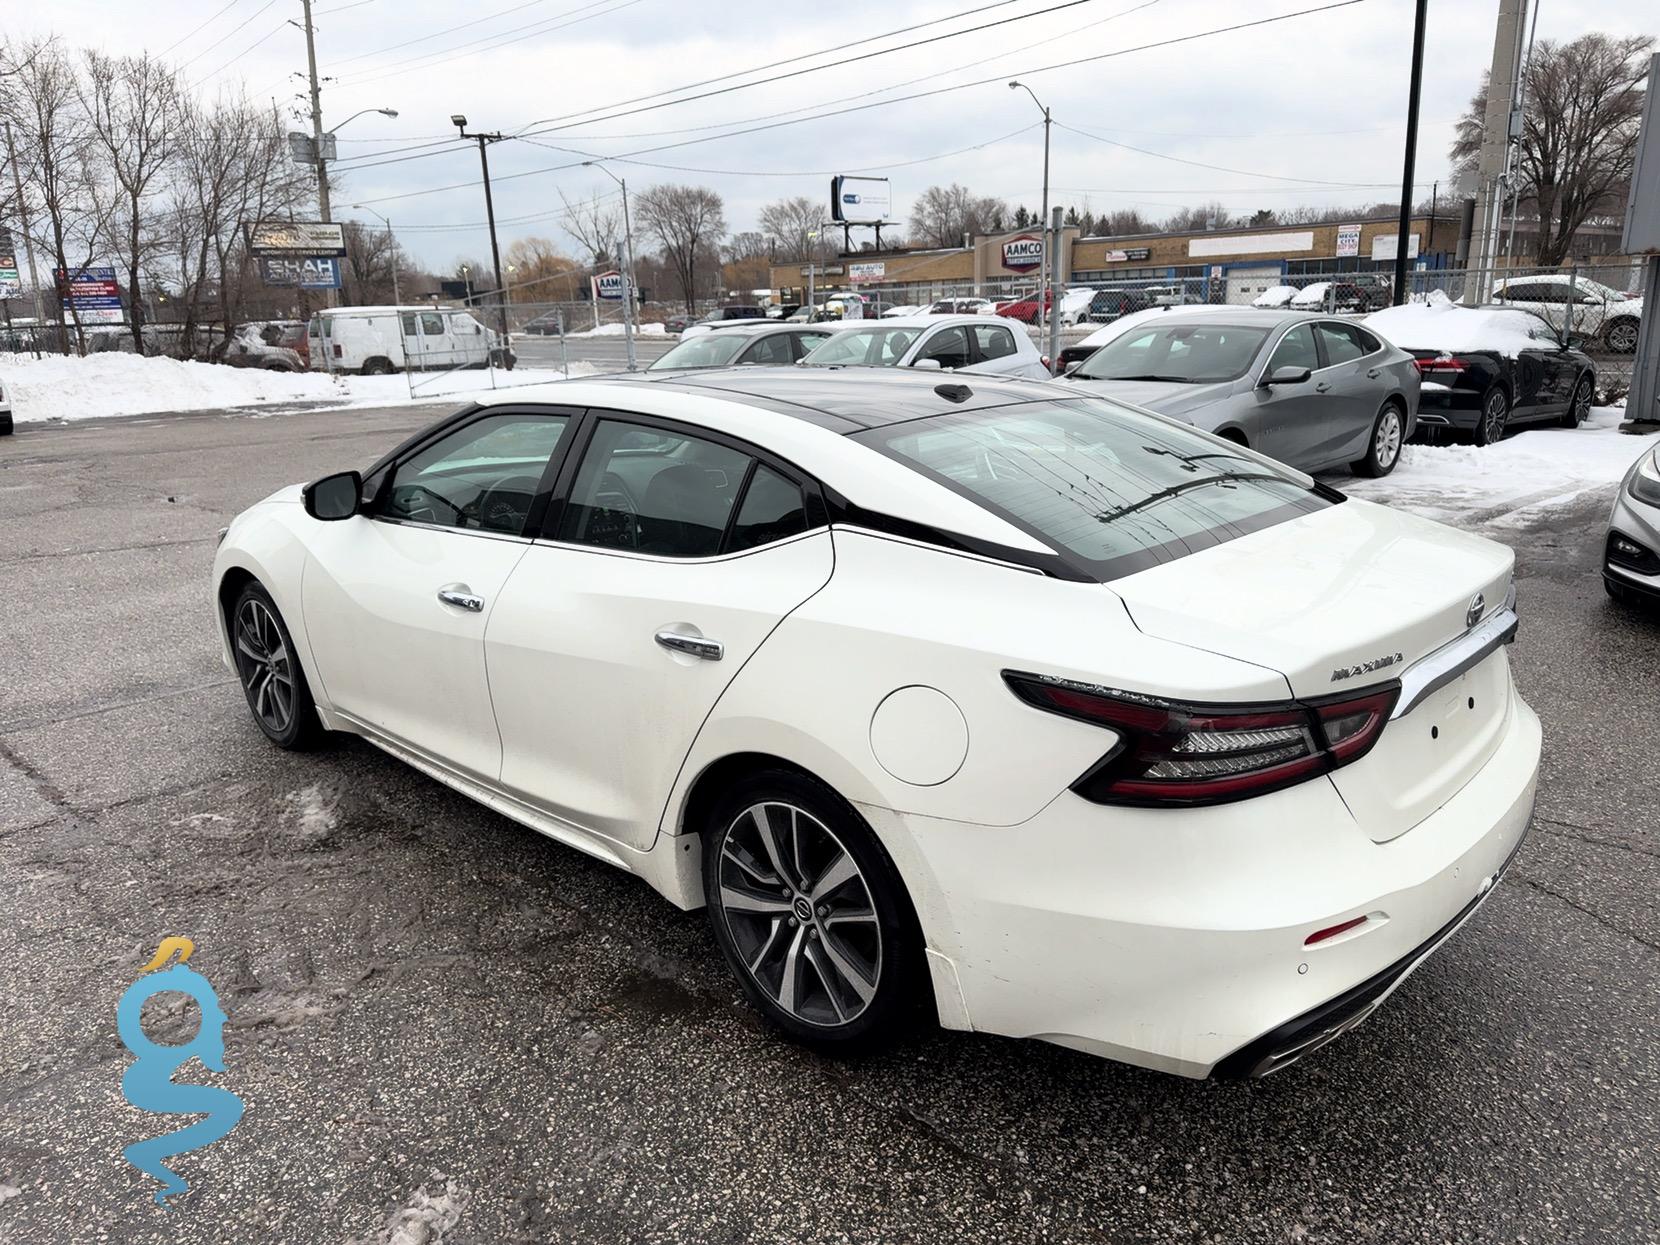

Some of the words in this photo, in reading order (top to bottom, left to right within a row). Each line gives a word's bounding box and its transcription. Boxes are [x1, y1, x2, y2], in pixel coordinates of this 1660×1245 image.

[1007, 243, 1042, 255] AAMCO
[268, 259, 333, 273] SHAH
[1331, 652, 1403, 682] MAXIMA
